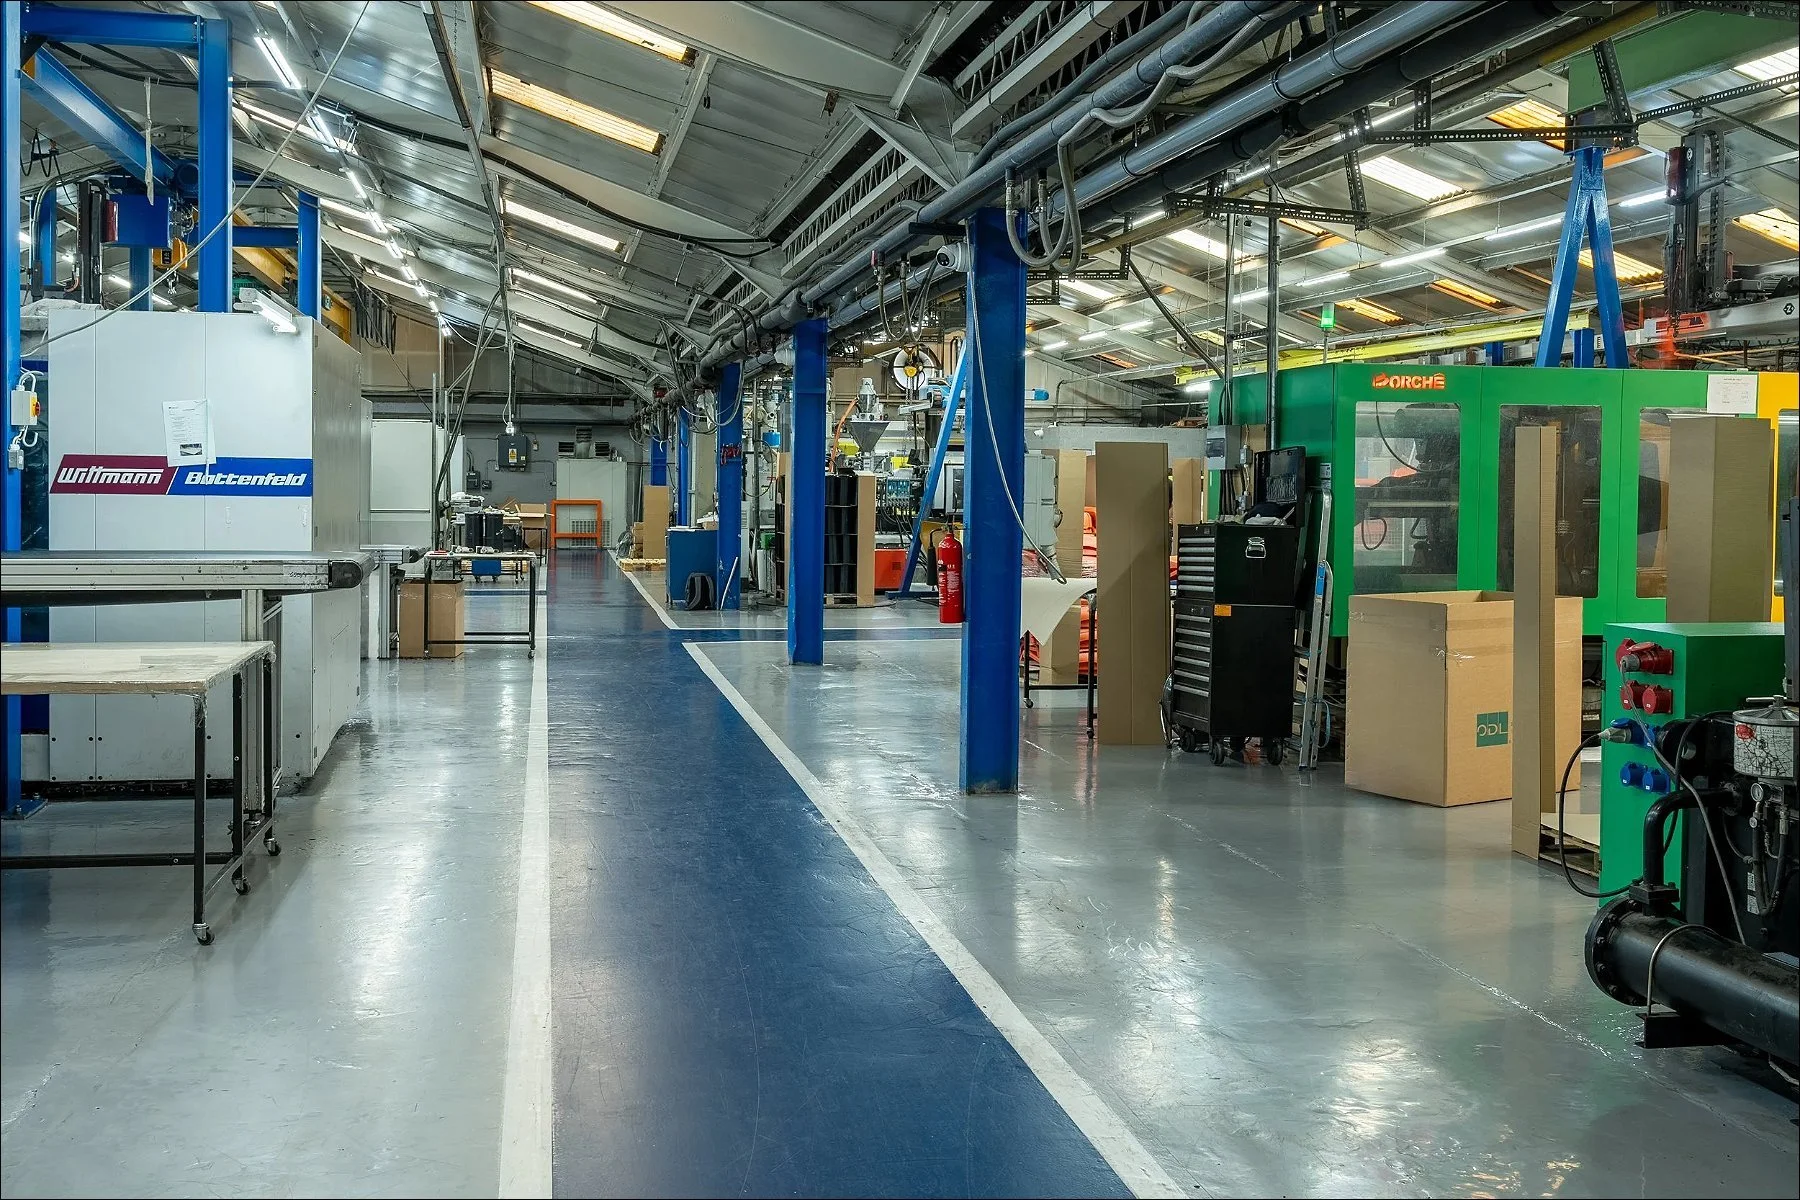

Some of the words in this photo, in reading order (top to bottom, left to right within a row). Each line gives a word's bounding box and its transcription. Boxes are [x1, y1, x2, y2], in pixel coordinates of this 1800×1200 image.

[57, 465, 164, 484] Wittmann
[184, 471, 308, 486] Battenfeld
[1477, 723, 1509, 737] ODL
